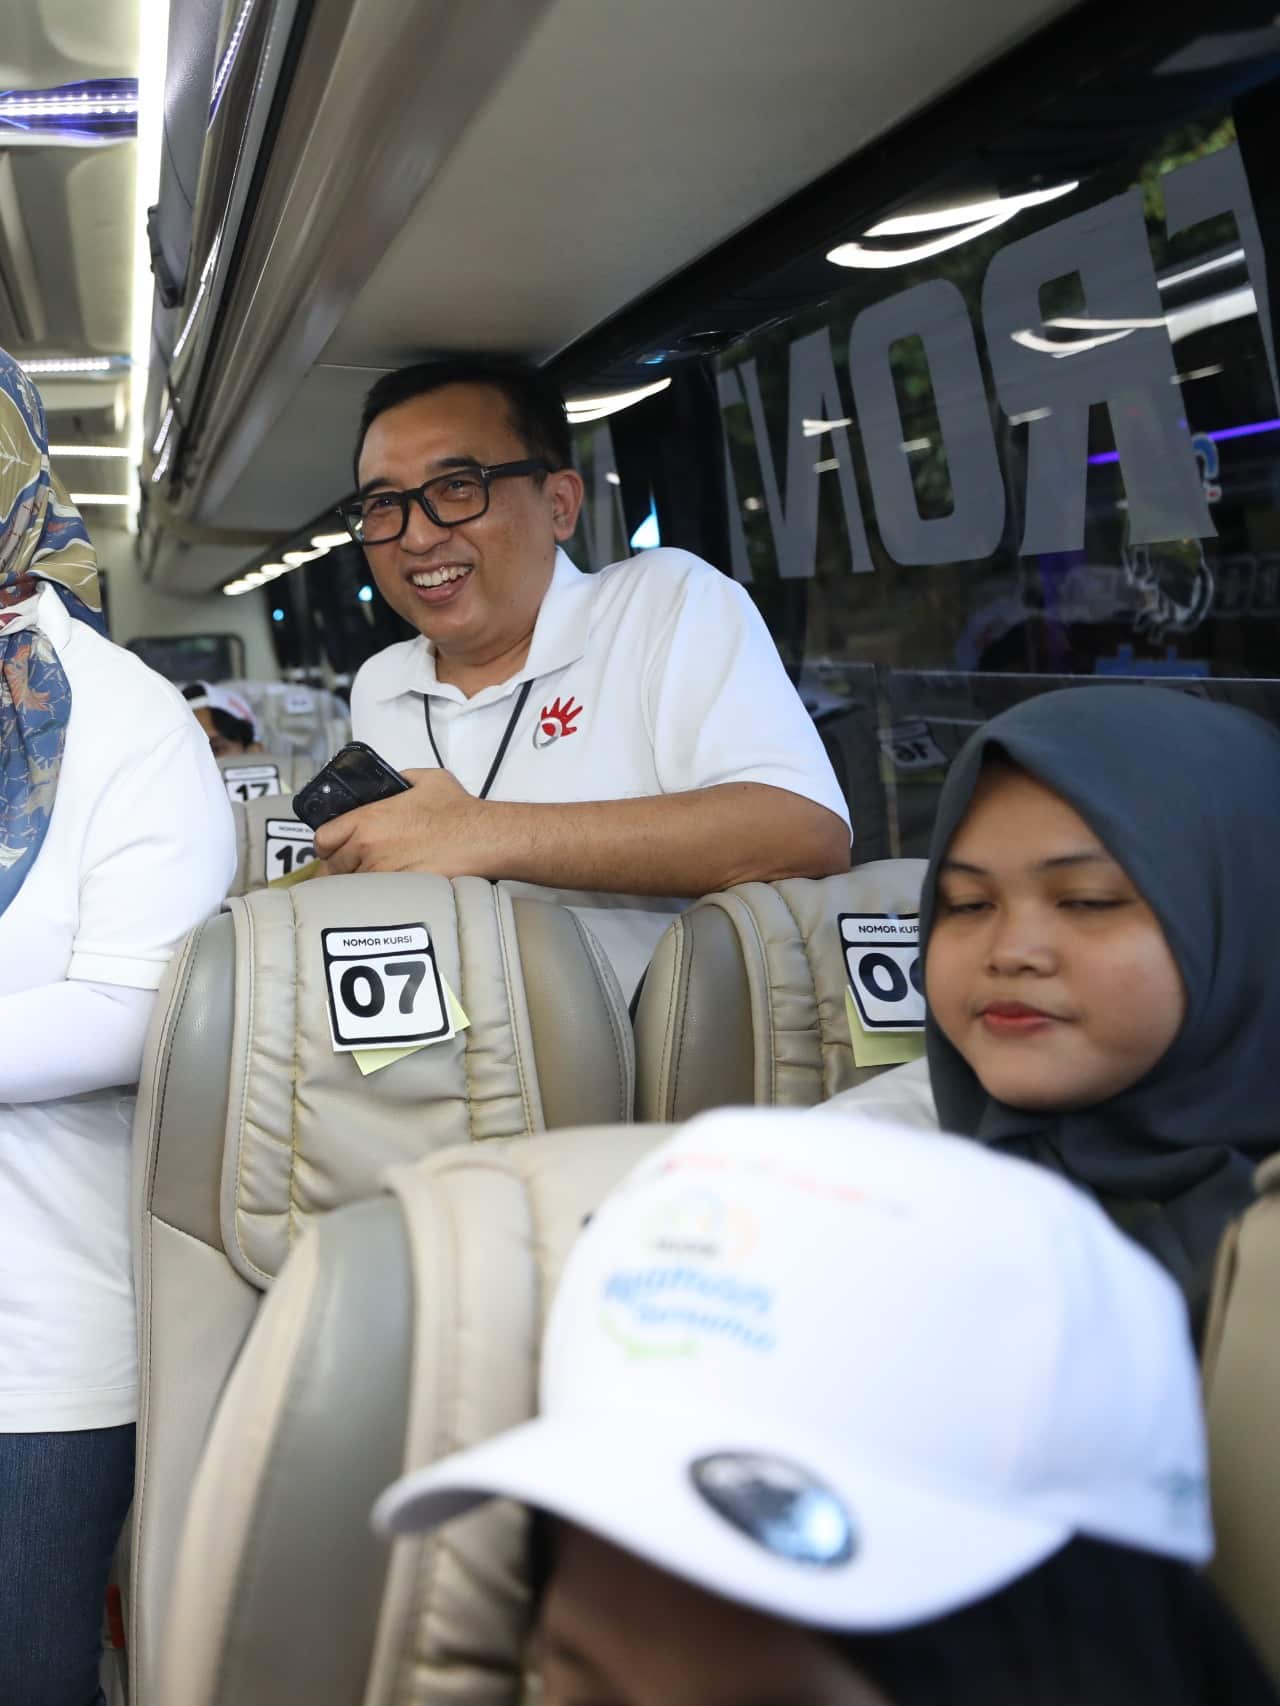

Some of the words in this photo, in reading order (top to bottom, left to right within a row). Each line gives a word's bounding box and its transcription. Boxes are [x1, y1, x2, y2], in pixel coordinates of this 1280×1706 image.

[858, 925, 897, 934] NOMOR
[899, 925, 920, 934] KUR
[342, 937, 381, 947] NOMOR
[383, 935, 413, 945] KURSI
[339, 960, 427, 1018] 07
